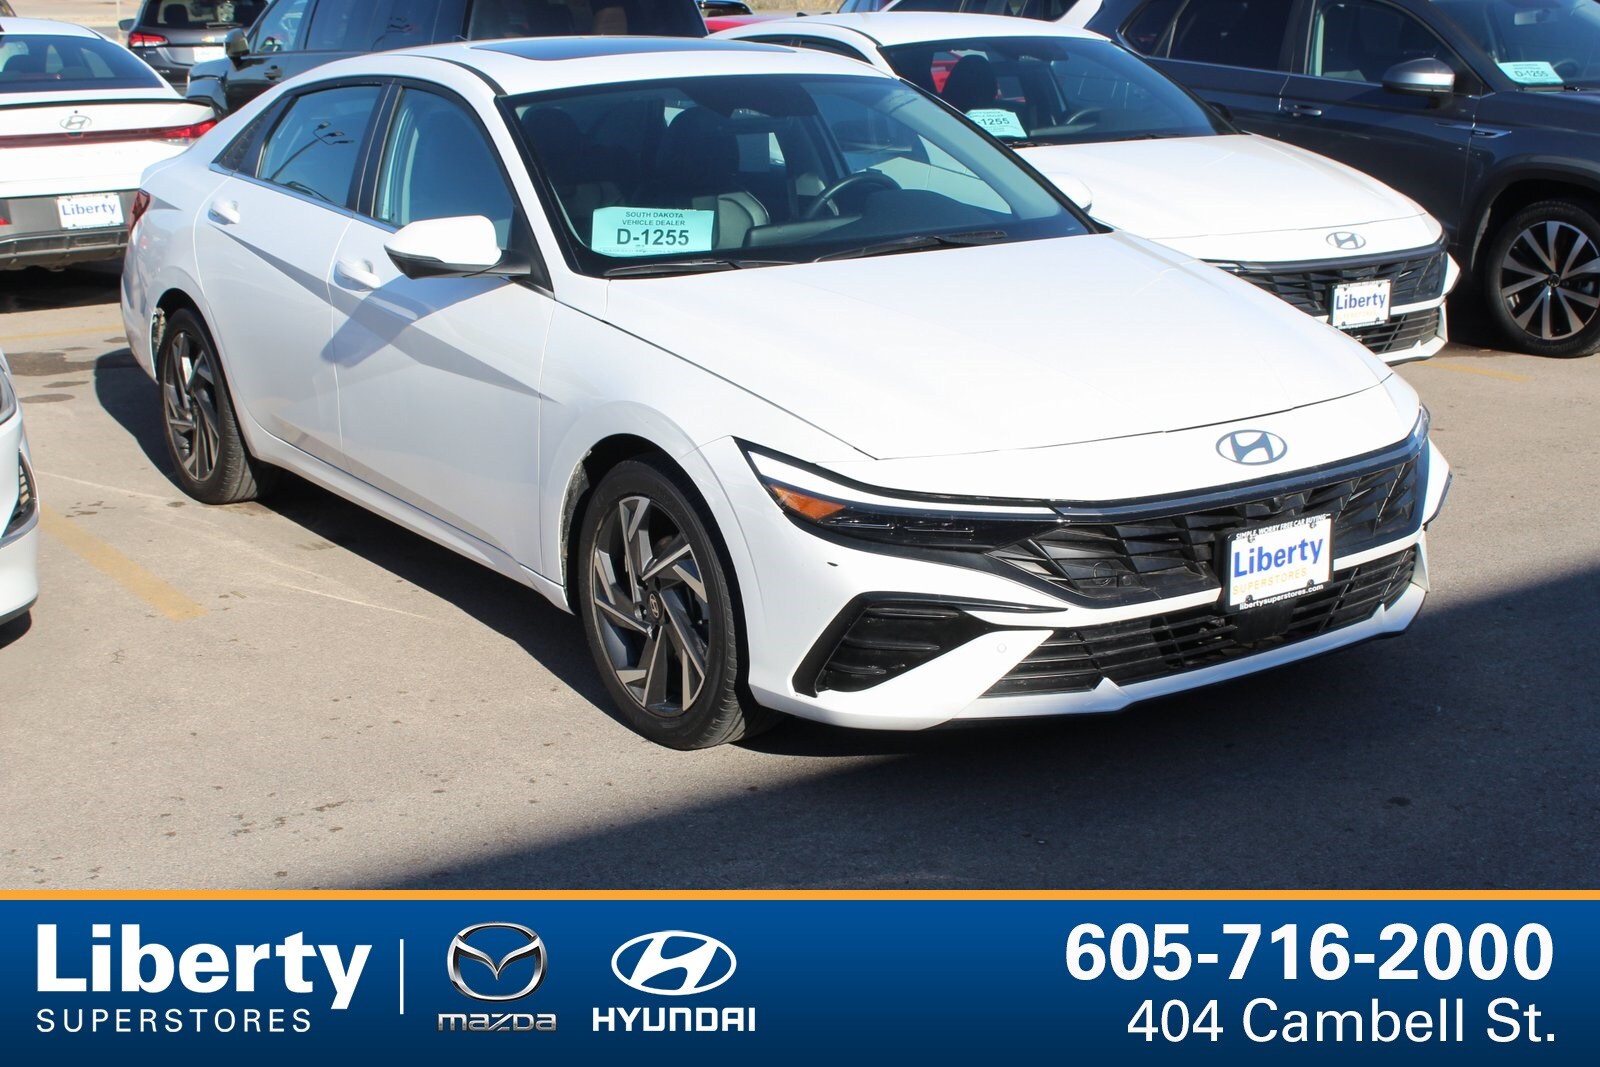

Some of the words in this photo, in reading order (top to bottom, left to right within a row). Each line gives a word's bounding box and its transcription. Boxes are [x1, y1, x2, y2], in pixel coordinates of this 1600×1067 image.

[977, 117, 1010, 126] -1255
[62, 203, 116, 216] Liberty
[616, 228, 689, 246] D-1255
[1335, 293, 1386, 310] Liberty
[1234, 538, 1323, 578] Liberty
[1232, 567, 1307, 595] SUPERSTORES
[1240, 584, 1324, 610] libertysuperstores.com
